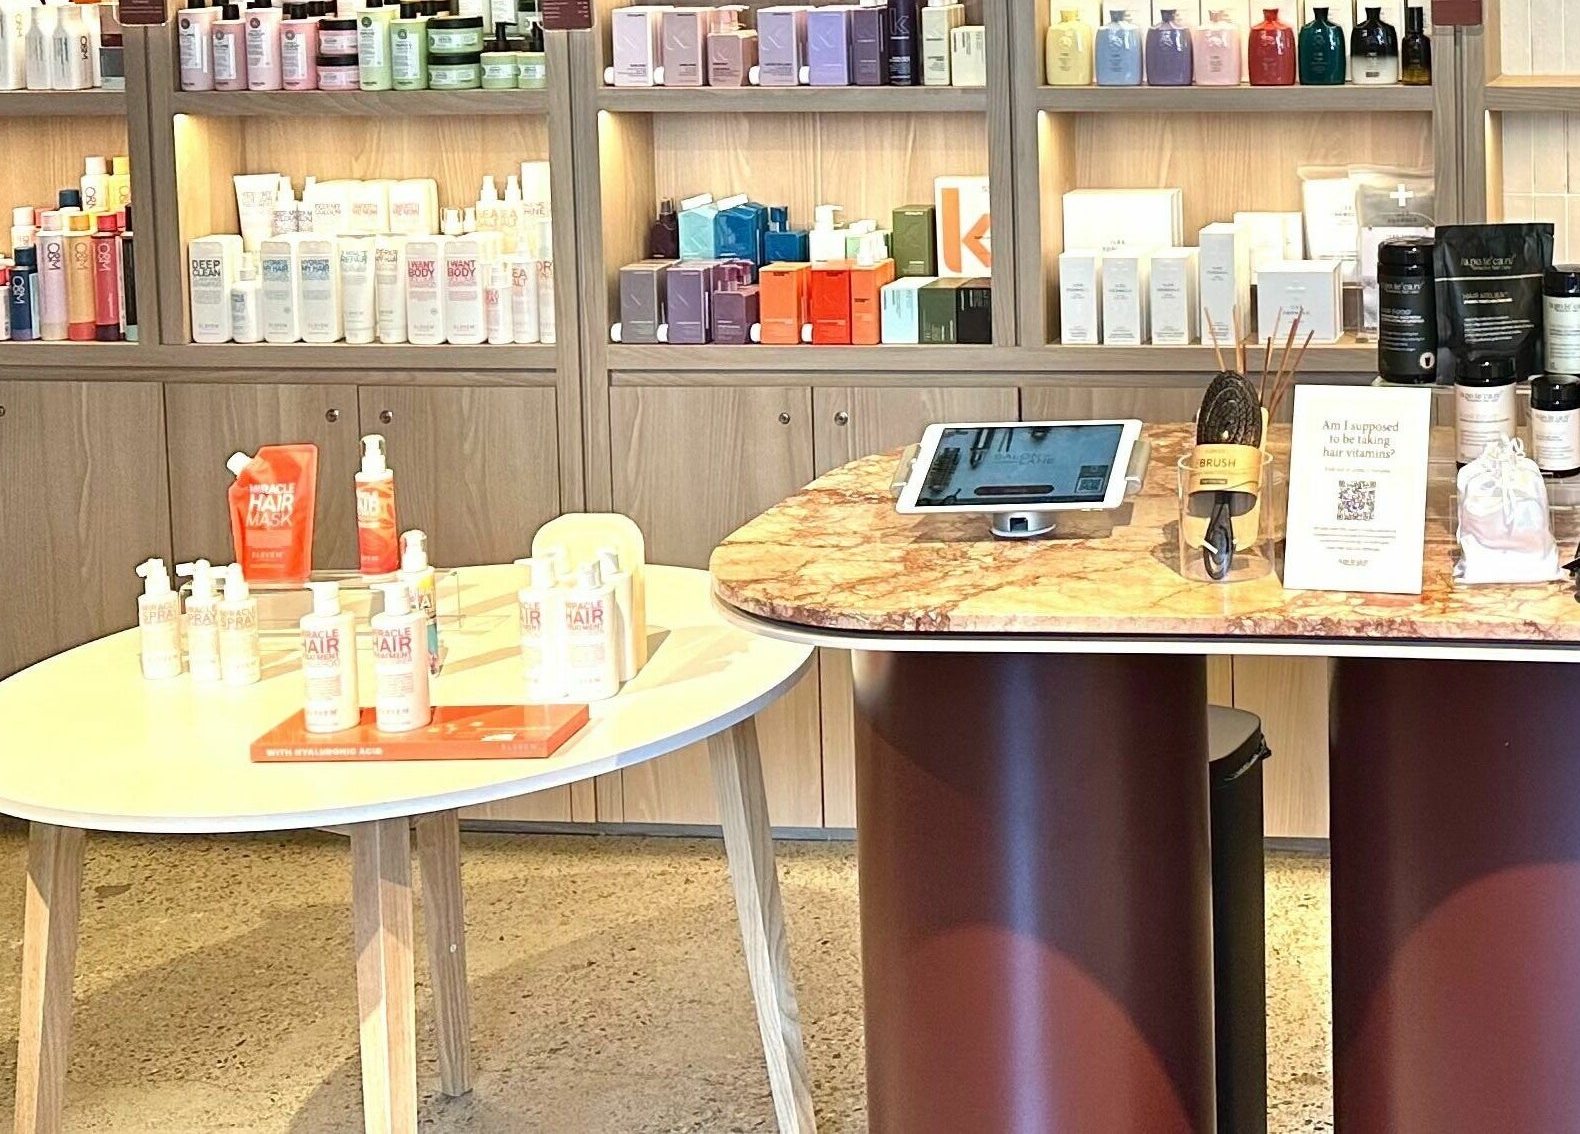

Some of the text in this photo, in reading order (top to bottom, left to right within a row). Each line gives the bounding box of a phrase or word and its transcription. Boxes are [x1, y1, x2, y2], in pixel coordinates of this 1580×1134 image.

[47, 242, 61, 271] O&M
[97, 242, 112, 272] O&M
[192, 260, 221, 268] DEEP
[412, 260, 436, 268] WANT
[451, 260, 475, 268] WANT
[192, 268, 221, 277] CLEAN
[408, 268, 436, 278] BODY
[447, 268, 476, 278] BODY
[12, 275, 25, 304] O&M
[1322, 420, 1340, 431] Am
[1350, 421, 1399, 432] supposed
[1329, 434, 1391, 447] to be taking
[1323, 447, 1396, 459] hair vitamins?
[1199, 458, 1236, 468] BRUSH
[249, 482, 295, 494] MIRACLE
[250, 494, 295, 512] HAIR
[246, 512, 293, 528] MASK
[565, 609, 604, 625] HAIR
[266, 746, 383, 756] WITH HYALURONIC ACID
